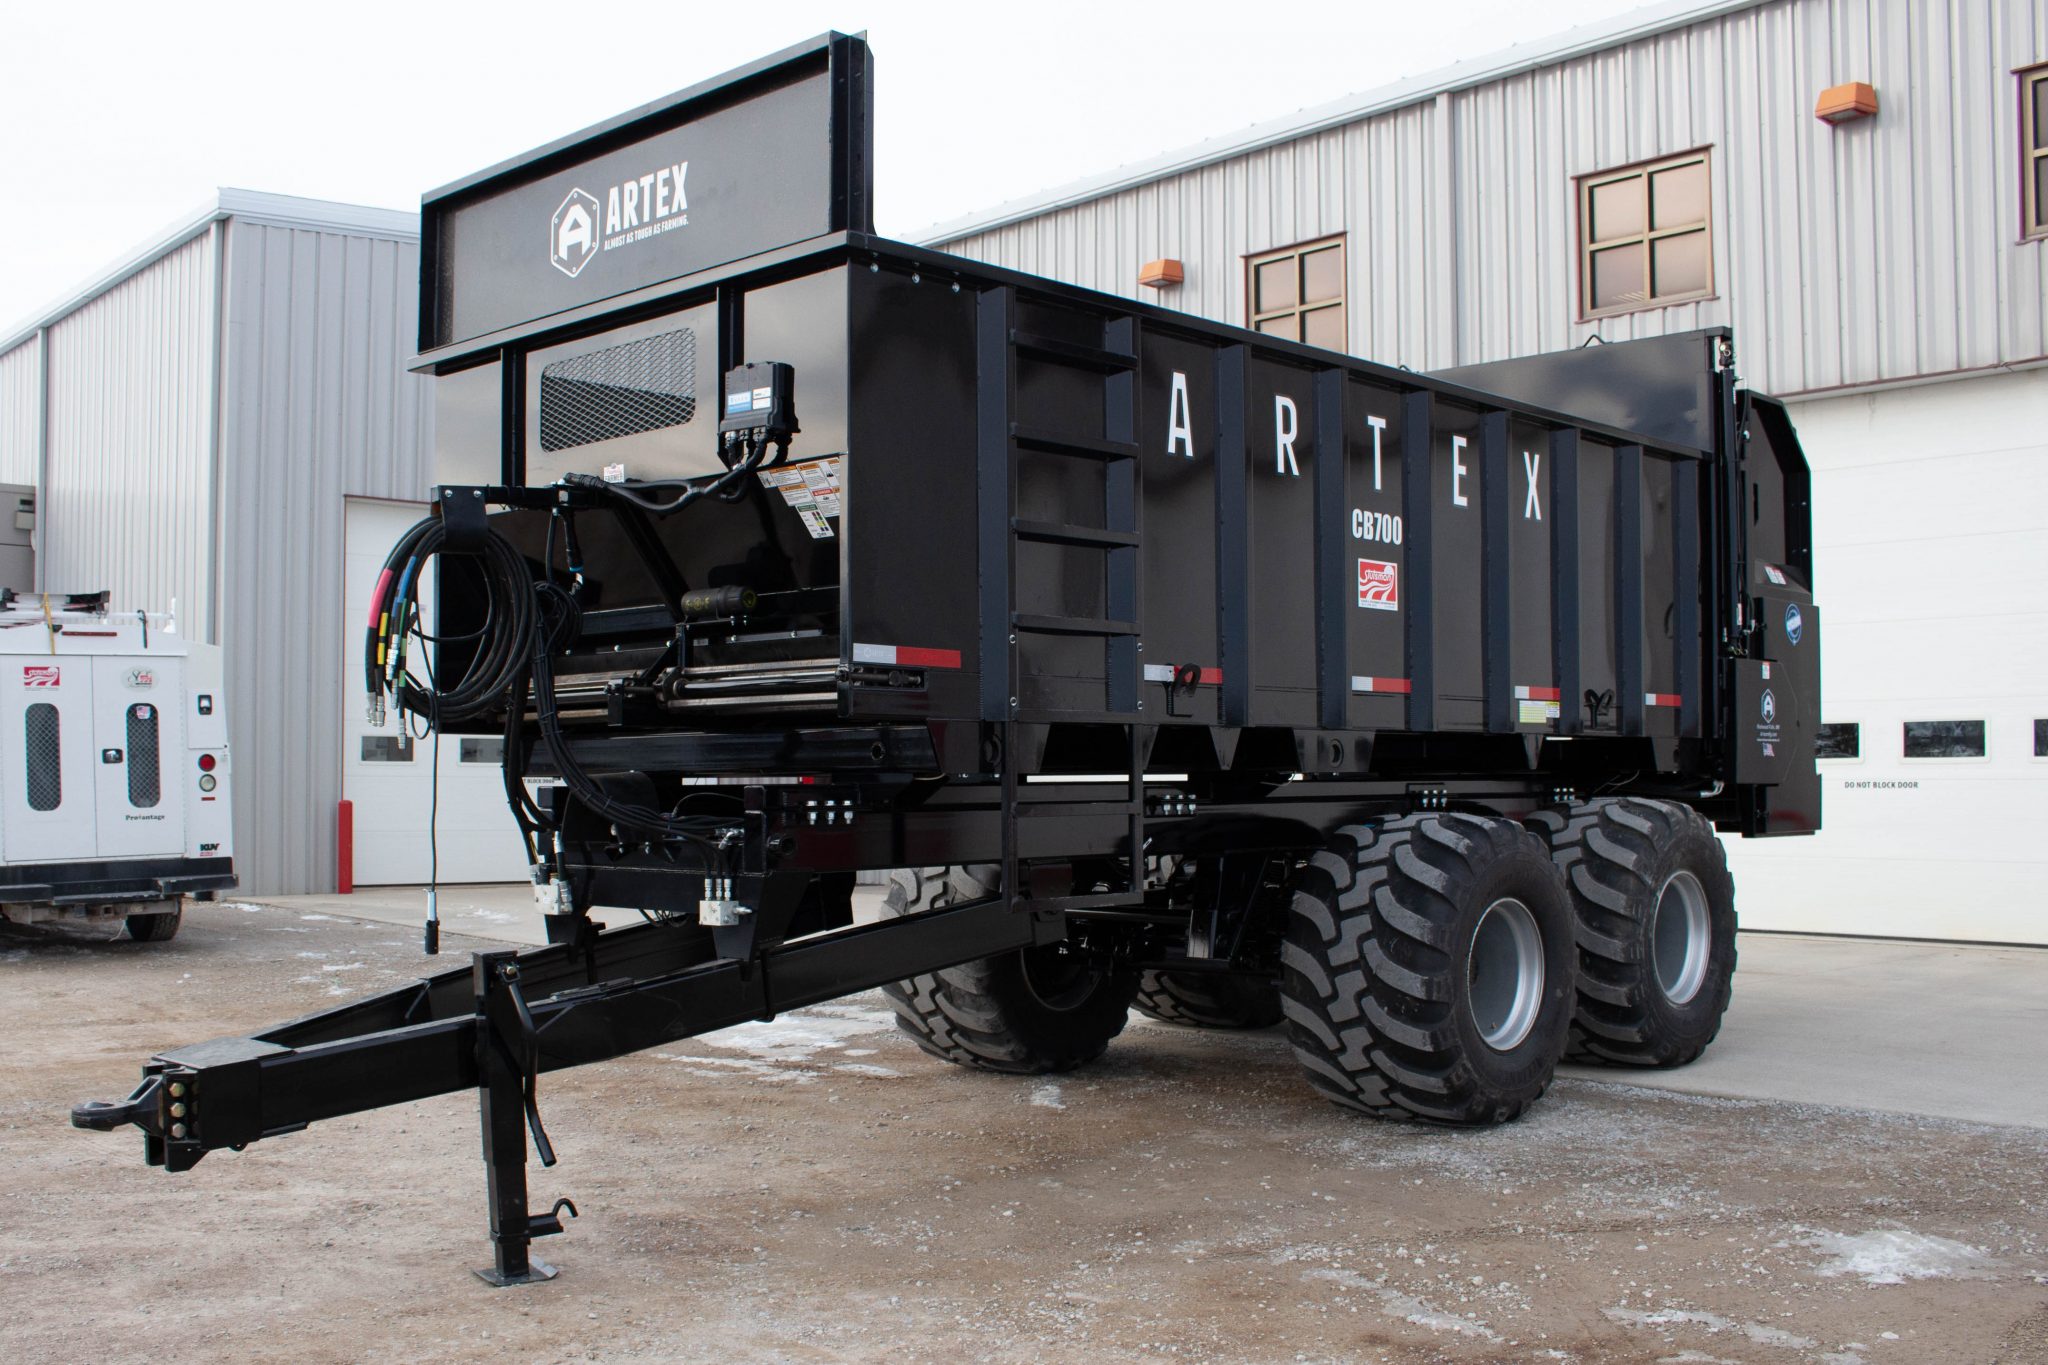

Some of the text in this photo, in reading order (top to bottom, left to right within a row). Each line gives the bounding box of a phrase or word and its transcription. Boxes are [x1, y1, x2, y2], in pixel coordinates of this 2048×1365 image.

[606, 161, 689, 235] ARTEX
[604, 234, 626, 251] ALMOST
[626, 231, 634, 244] AS
[634, 226, 653, 241] TOUGH
[653, 222, 661, 235] AS
[1352, 508, 1402, 545] CB700
[1844, 781, 1918, 789] DO NOT BLOCK DOOR
